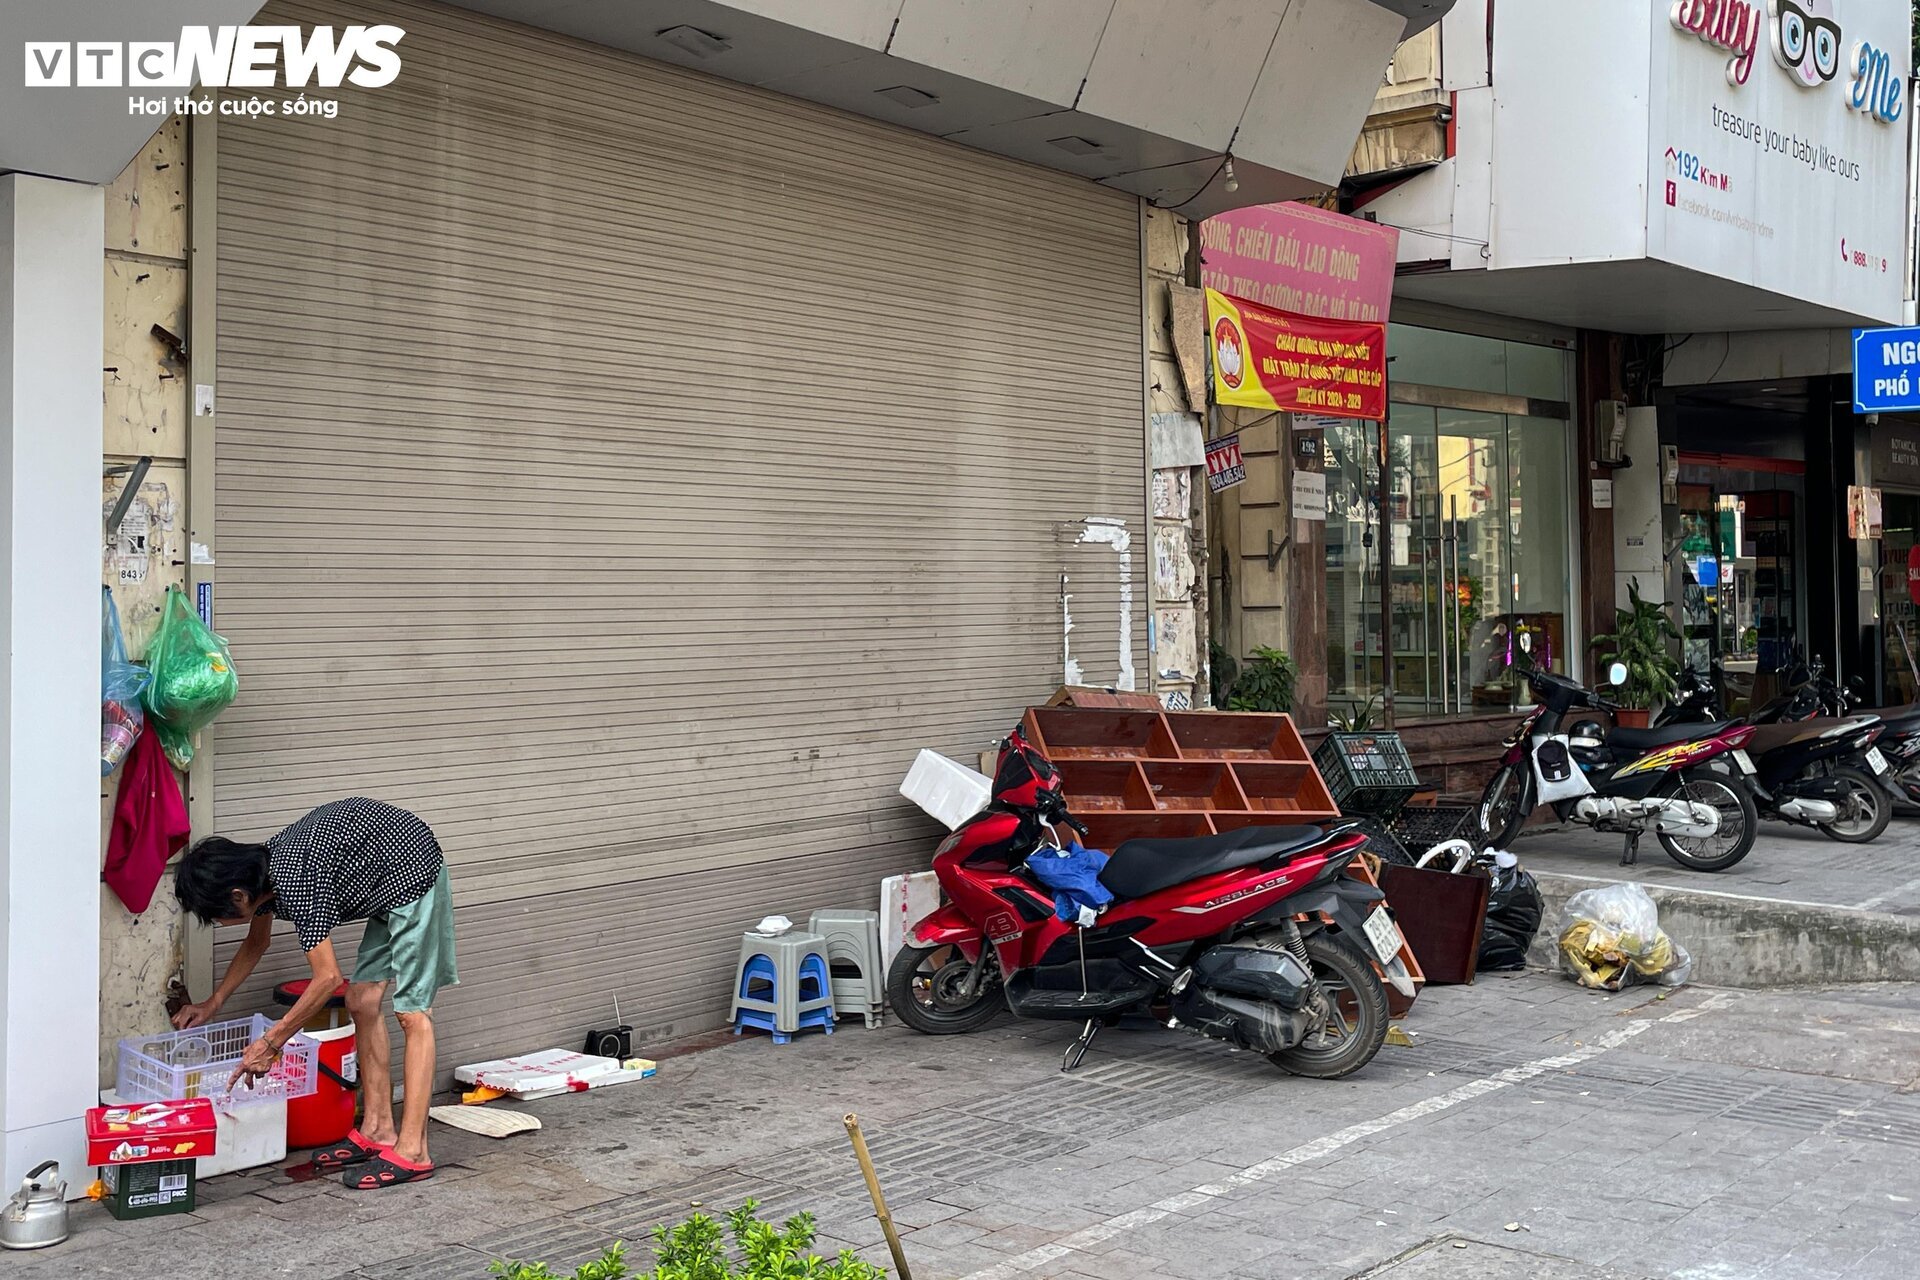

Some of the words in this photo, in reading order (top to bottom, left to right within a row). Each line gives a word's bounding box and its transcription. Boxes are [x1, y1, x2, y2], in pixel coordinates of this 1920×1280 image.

[1853, 42, 1902, 121] Me
[1677, 150, 1699, 181] 192
[1712, 103, 1761, 143] treasure
[1765, 127, 1789, 154] your
[1793, 134, 1818, 171] baby
[1819, 144, 1836, 173] like
[1838, 158, 1860, 182] ours
[1236, 221, 1273, 262] CHIẾN
[1304, 242, 1326, 274] LAO
[1329, 245, 1360, 283] ĐỘNG
[1883, 341, 1920, 366] NG
[1874, 369, 1910, 397] PHỐ
